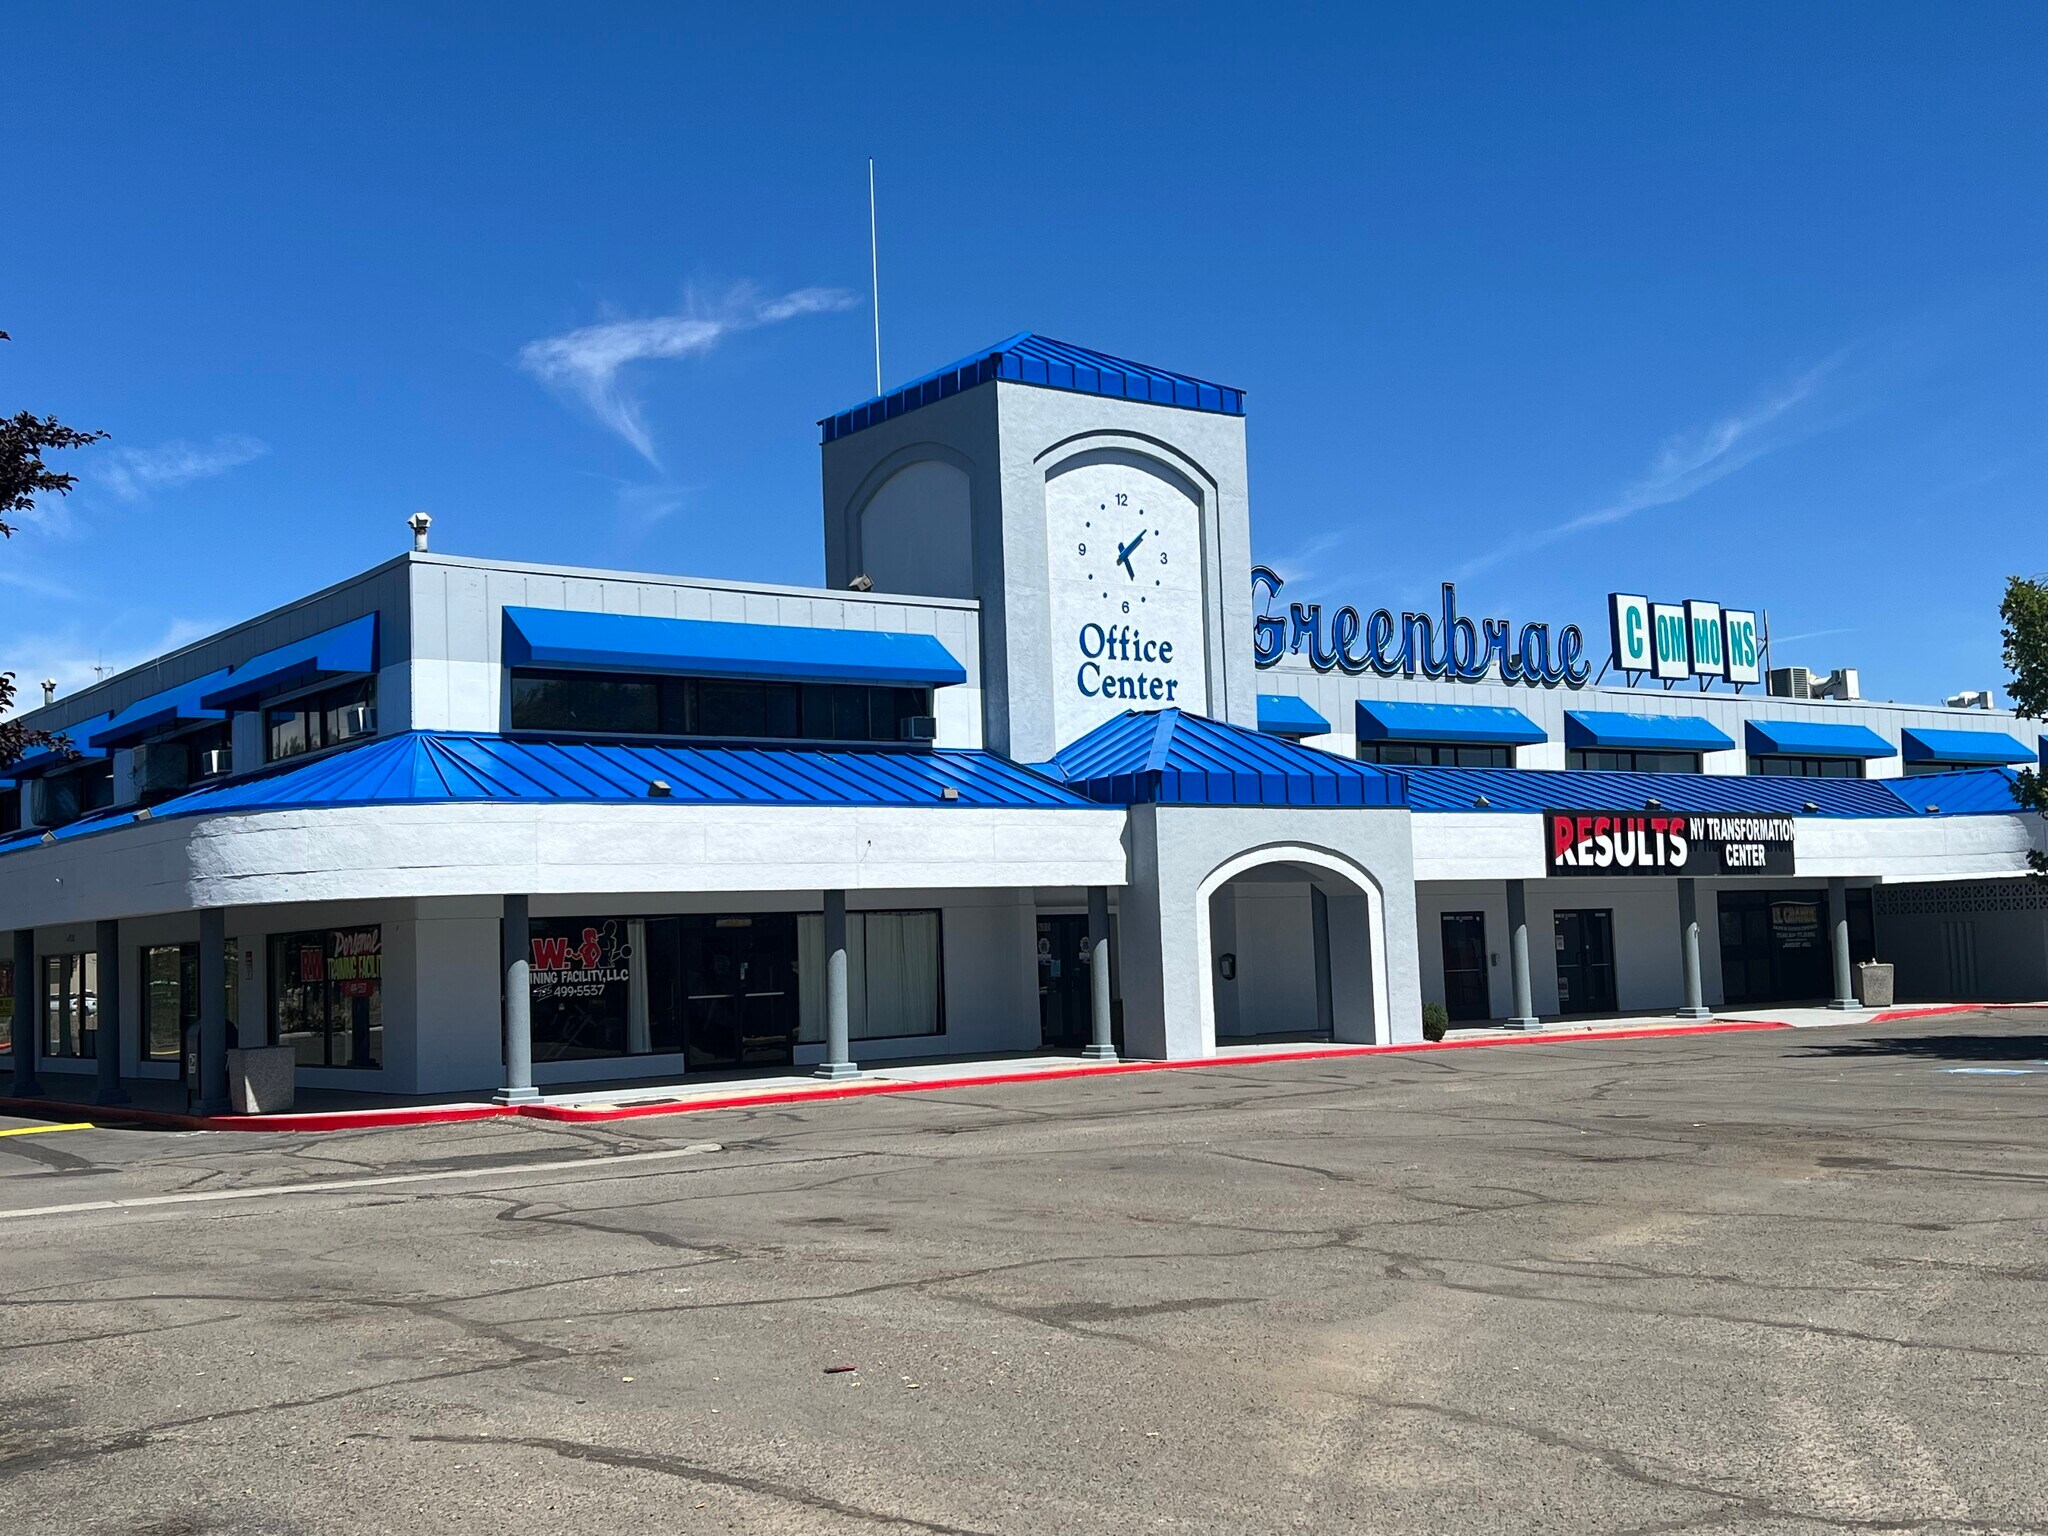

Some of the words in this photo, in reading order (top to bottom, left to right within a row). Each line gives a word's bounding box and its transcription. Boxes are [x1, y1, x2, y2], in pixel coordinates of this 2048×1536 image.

[1115, 493, 1128, 507] 12
[1078, 543, 1087, 556] 9
[1160, 552, 1168, 565] 3
[1121, 601, 1130, 614] 6
[1251, 564, 1592, 689] Greenbrae
[1626, 605, 1756, 668] COMMONS
[1079, 622, 1173, 664] Office
[1077, 661, 1178, 702] Center
[1553, 815, 1688, 867] RESULTS
[1690, 817, 1704, 841] NV
[1707, 817, 1796, 842] TRANSFORMATION
[1725, 844, 1767, 867] CENTER
[359, 955, 383, 979] FACILIT
[530, 972, 559, 986] INING
